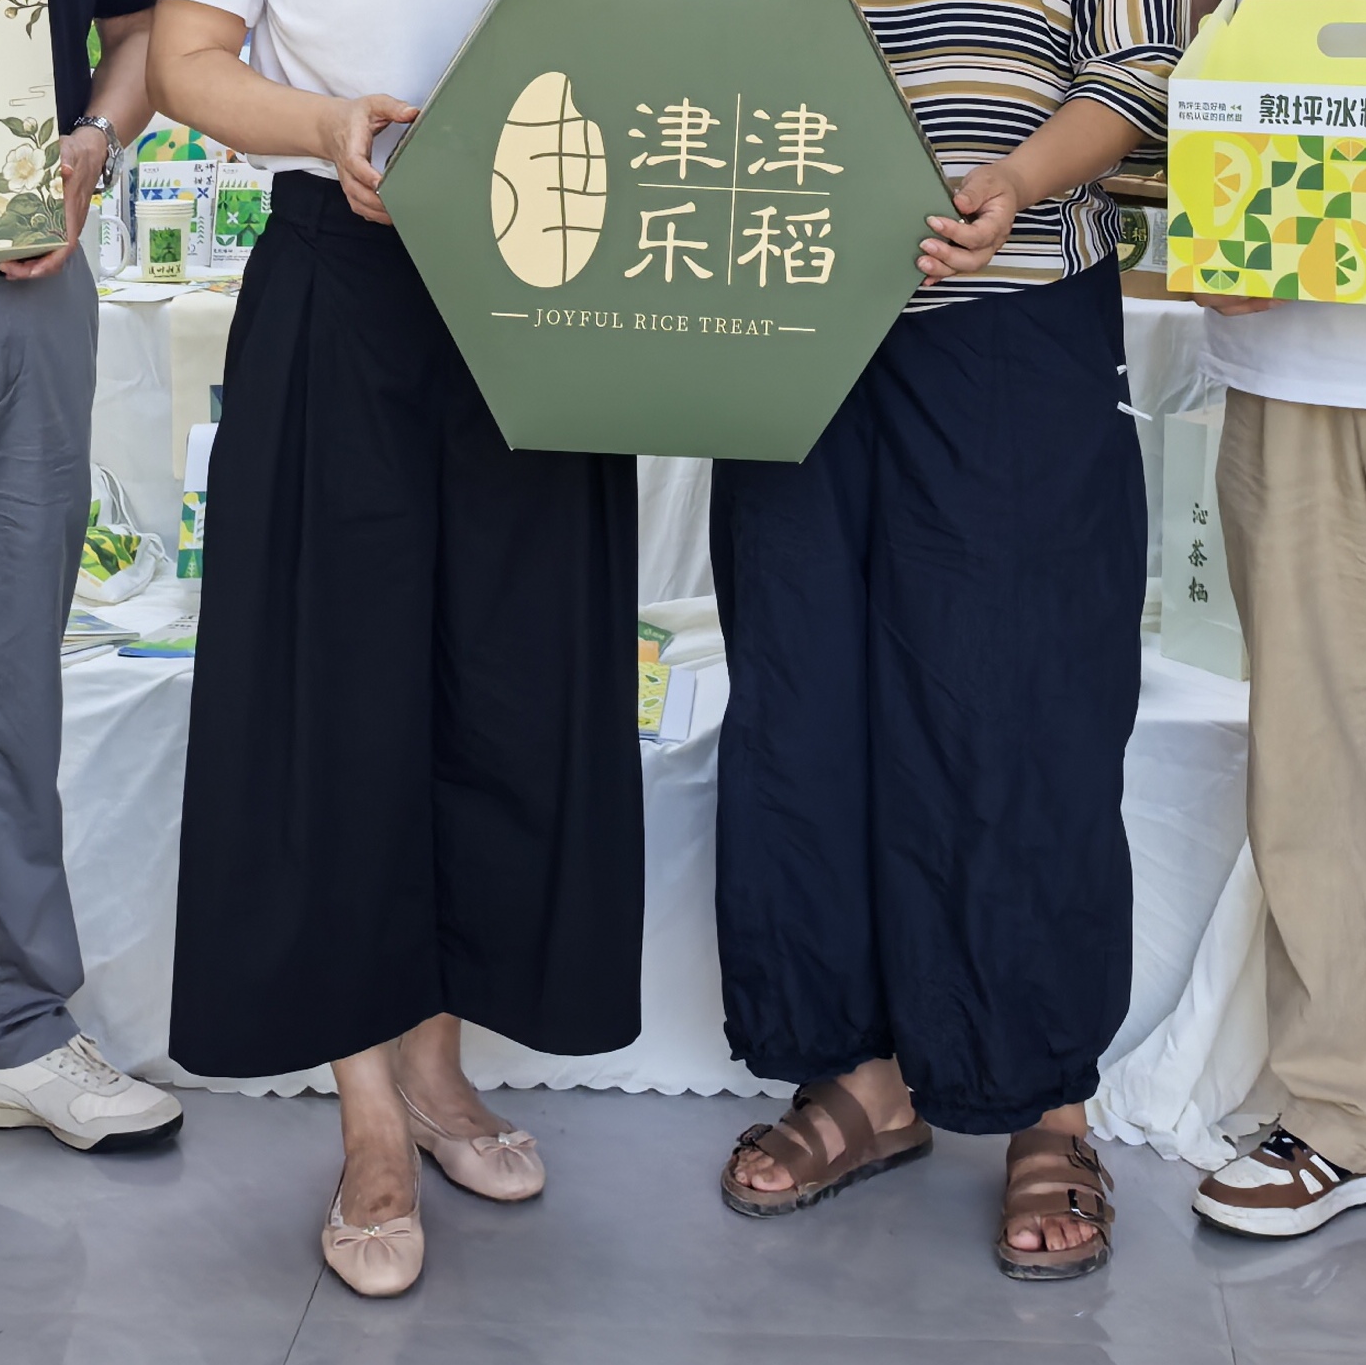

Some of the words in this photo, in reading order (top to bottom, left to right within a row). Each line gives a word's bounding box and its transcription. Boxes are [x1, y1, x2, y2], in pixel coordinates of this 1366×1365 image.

[628, 97, 845, 185] 津津
[1178, 100, 1227, 112] 熟坪生态好柚
[624, 202, 836, 288] 乐稻
[534, 308, 625, 329] JOYFUL
[634, 313, 690, 333] RICE
[699, 317, 774, 336] TREAT
[1187, 502, 1209, 604] 沁茶栖
